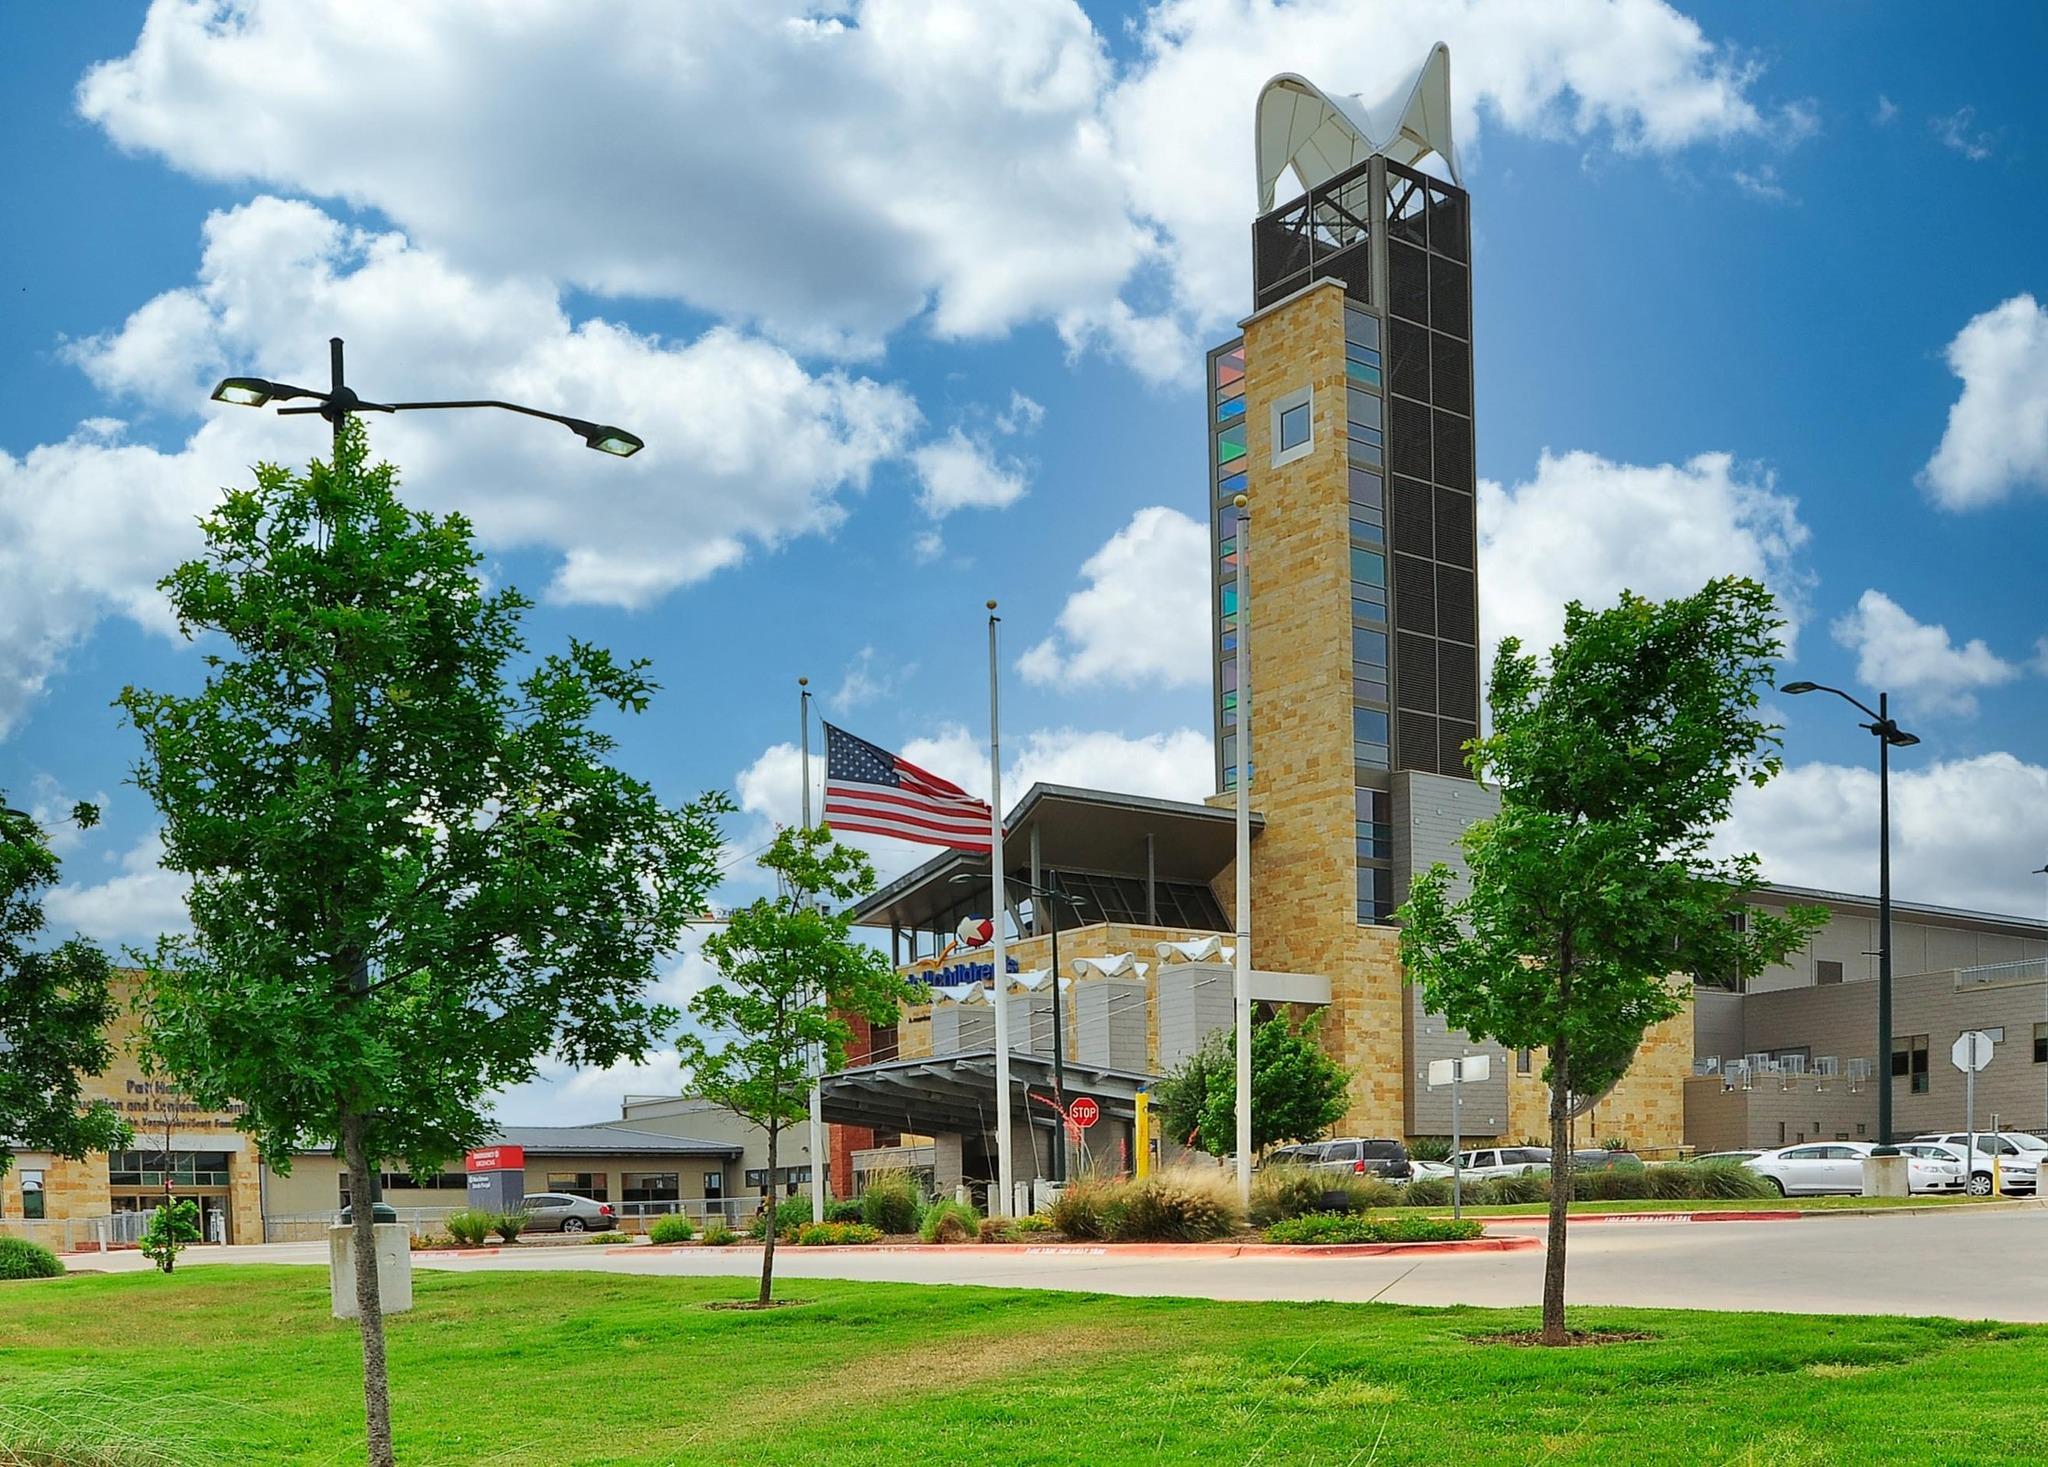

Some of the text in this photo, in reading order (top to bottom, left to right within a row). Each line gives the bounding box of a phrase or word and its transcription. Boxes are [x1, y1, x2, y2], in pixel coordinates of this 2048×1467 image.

[932, 955, 1019, 987] childre's
[126, 1080, 149, 1094] Pat
[127, 1098, 149, 1112] and
[1073, 1107, 1096, 1118] STOP
